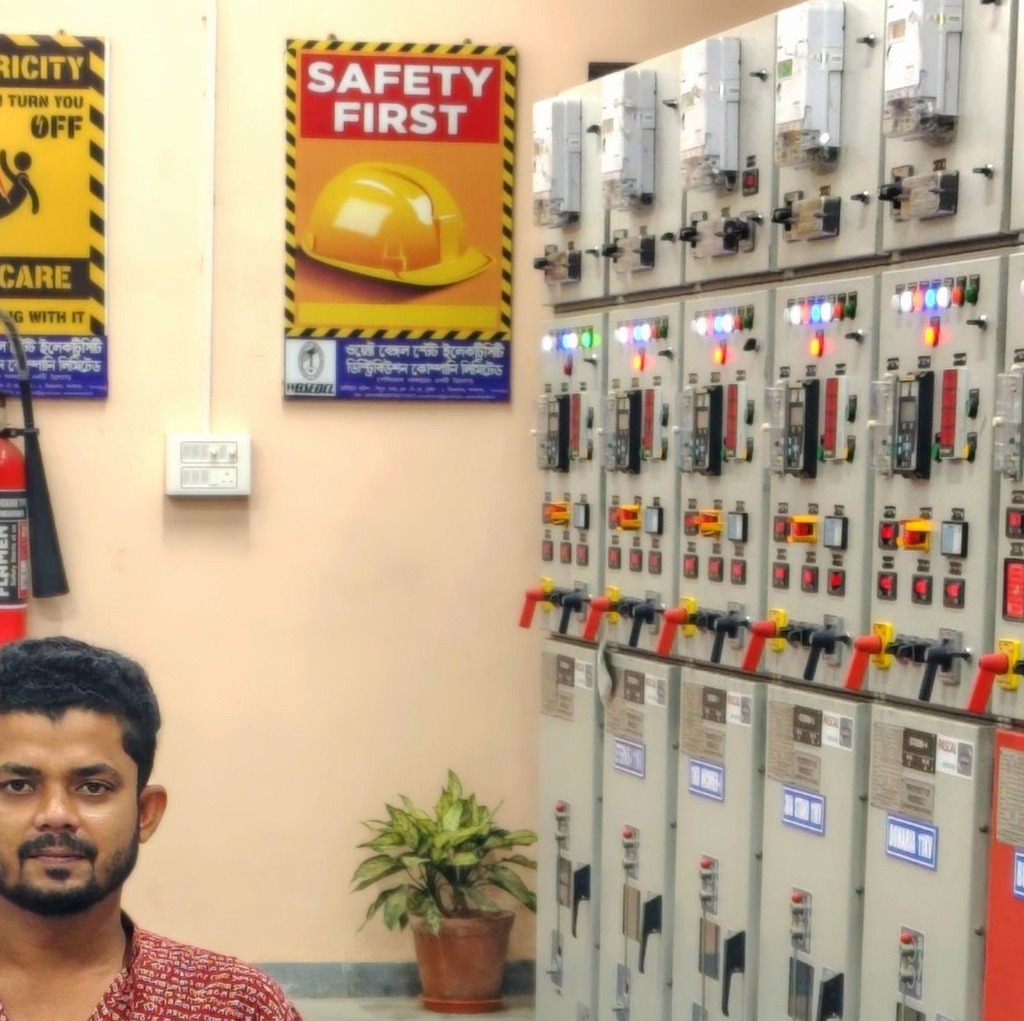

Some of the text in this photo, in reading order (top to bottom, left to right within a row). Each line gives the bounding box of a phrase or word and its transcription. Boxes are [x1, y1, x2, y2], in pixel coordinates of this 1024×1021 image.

[307, 61, 493, 97] SAFETY
[8, 94, 49, 108] TURN
[54, 95, 84, 109] YOU
[30, 114, 83, 139] OFF
[333, 101, 467, 136] FIRST
[29, 310, 67, 324] WITH
[72, 311, 86, 324] IT
